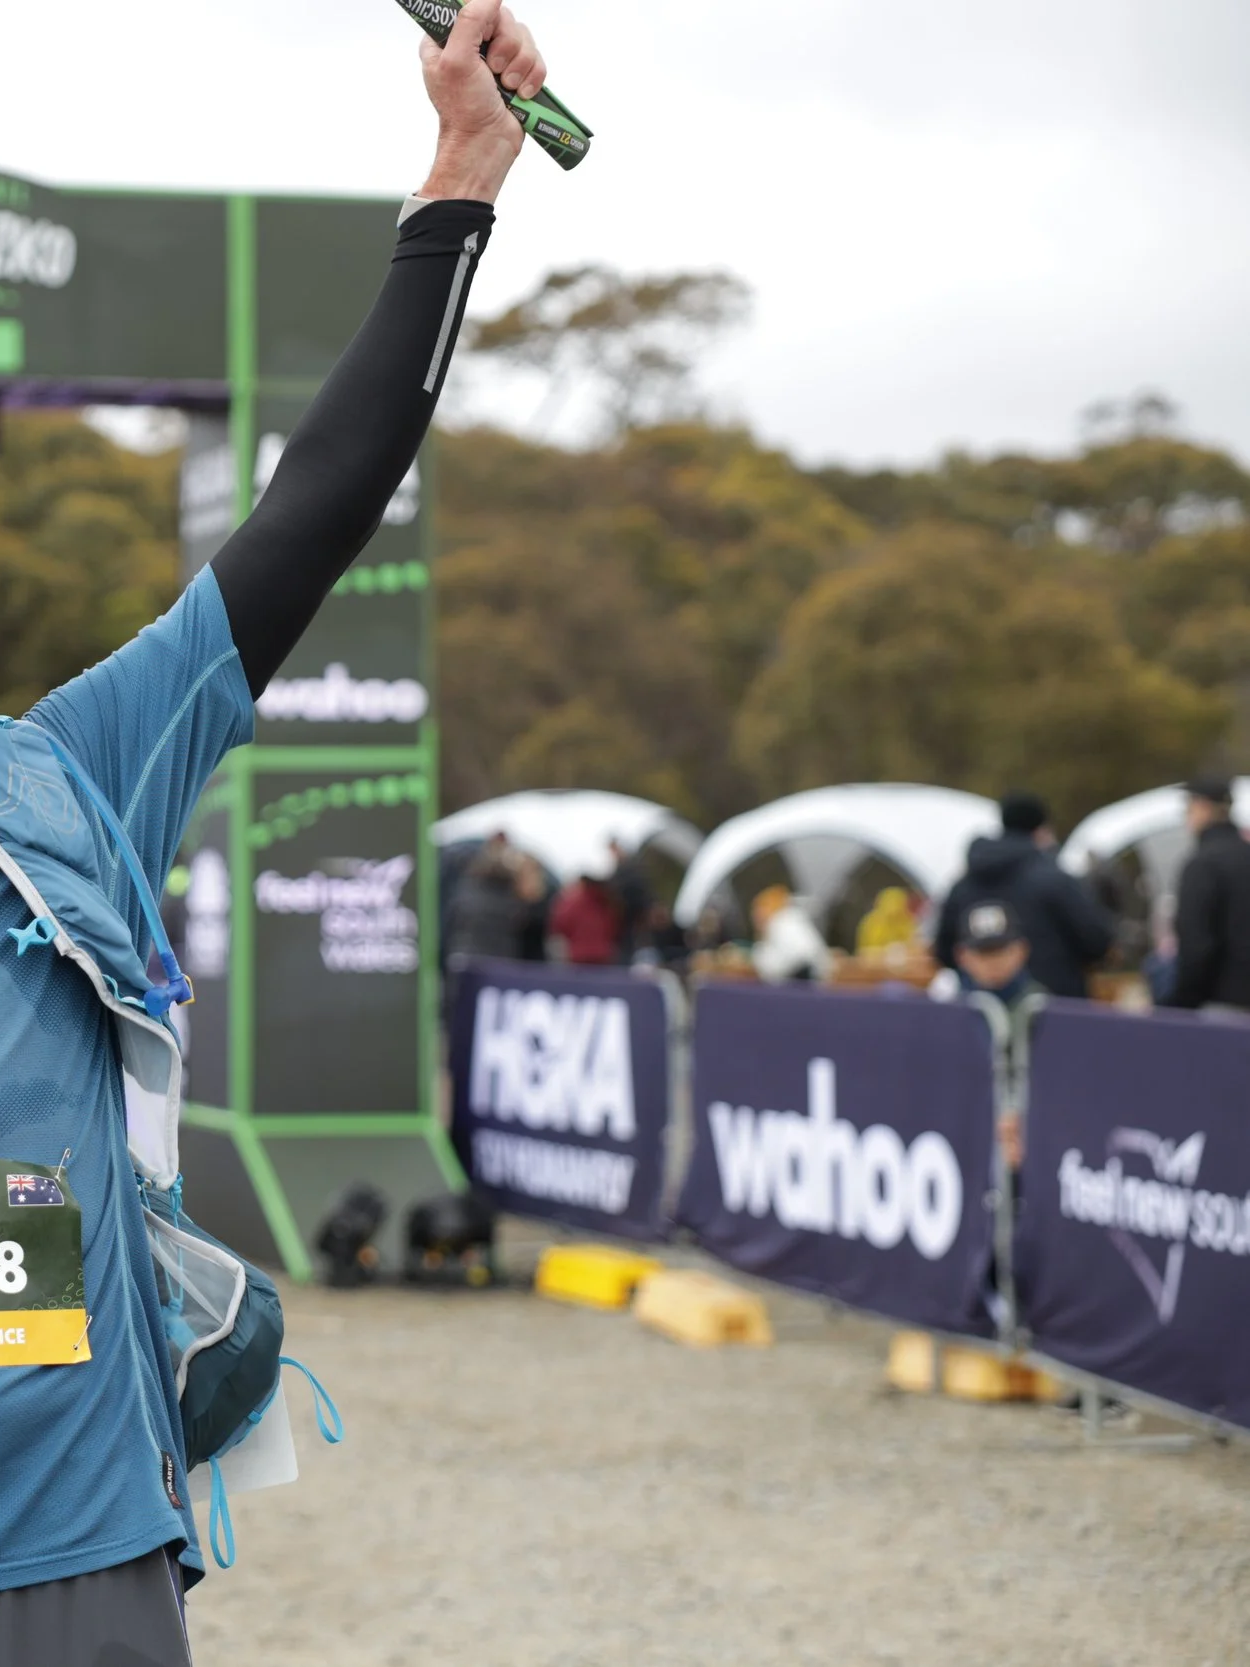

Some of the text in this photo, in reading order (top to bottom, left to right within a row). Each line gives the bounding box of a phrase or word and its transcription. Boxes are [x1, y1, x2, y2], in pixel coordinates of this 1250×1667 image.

[559, 131, 572, 145] 27
[468, 985, 637, 1143] HOKA
[707, 1056, 964, 1261] wahoo
